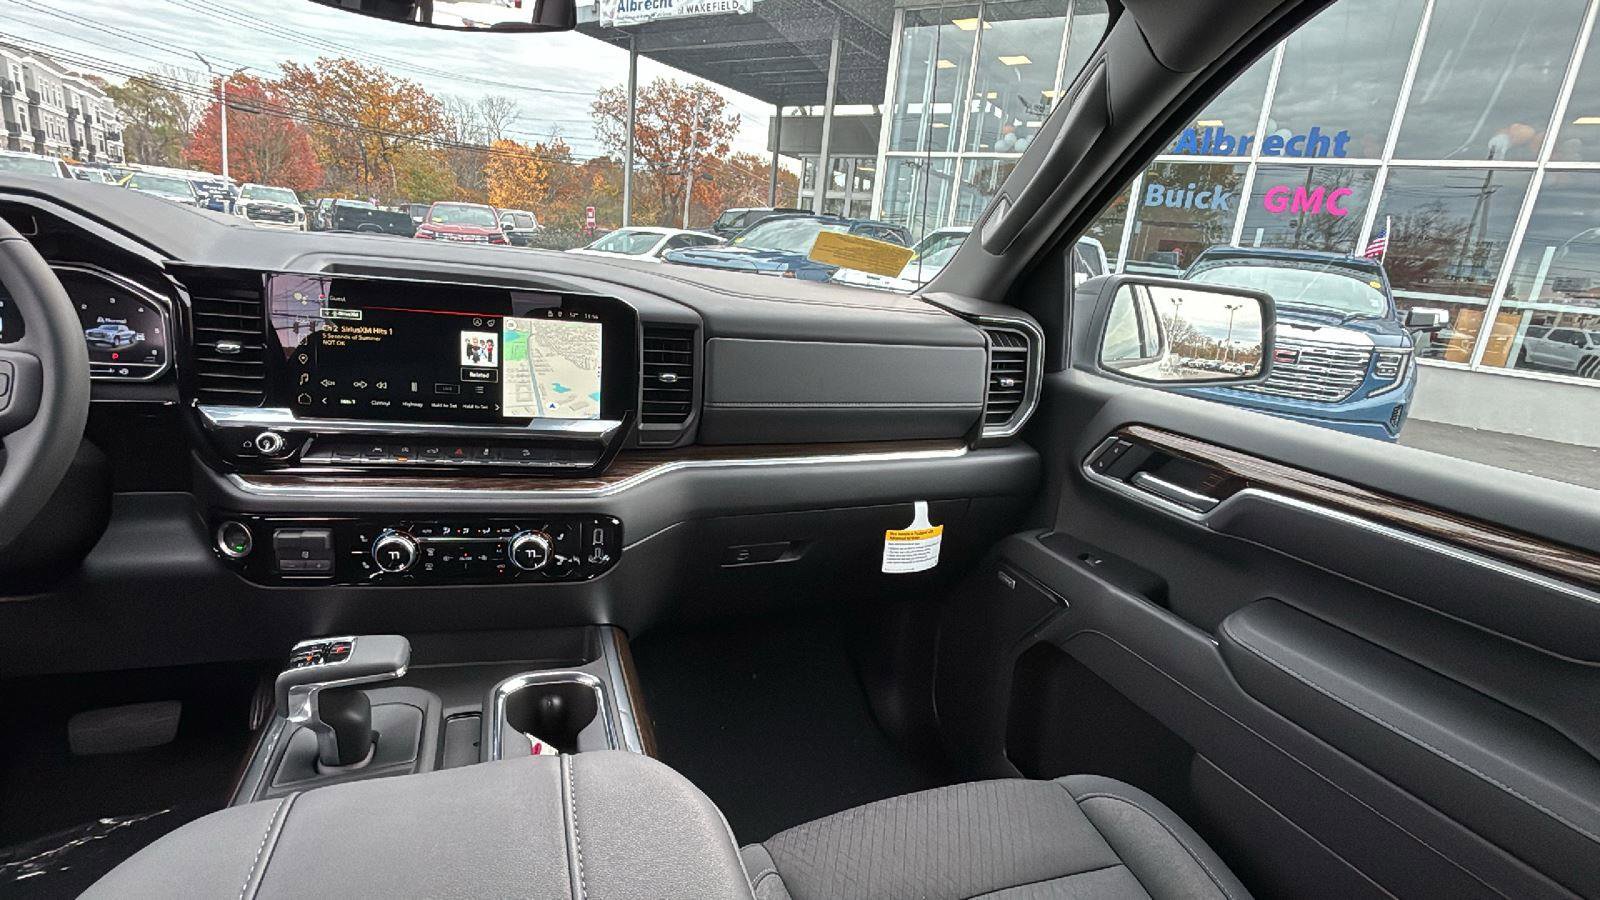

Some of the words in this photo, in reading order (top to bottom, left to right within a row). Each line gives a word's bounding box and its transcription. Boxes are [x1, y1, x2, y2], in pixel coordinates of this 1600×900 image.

[687, 1, 739, 14] WAKEFIELD
[1174, 127, 1350, 158] Albrecht
[1144, 182, 1233, 211] Buick
[1263, 185, 1354, 217] GMC
[341, 326, 373, 334] SiriusXM
